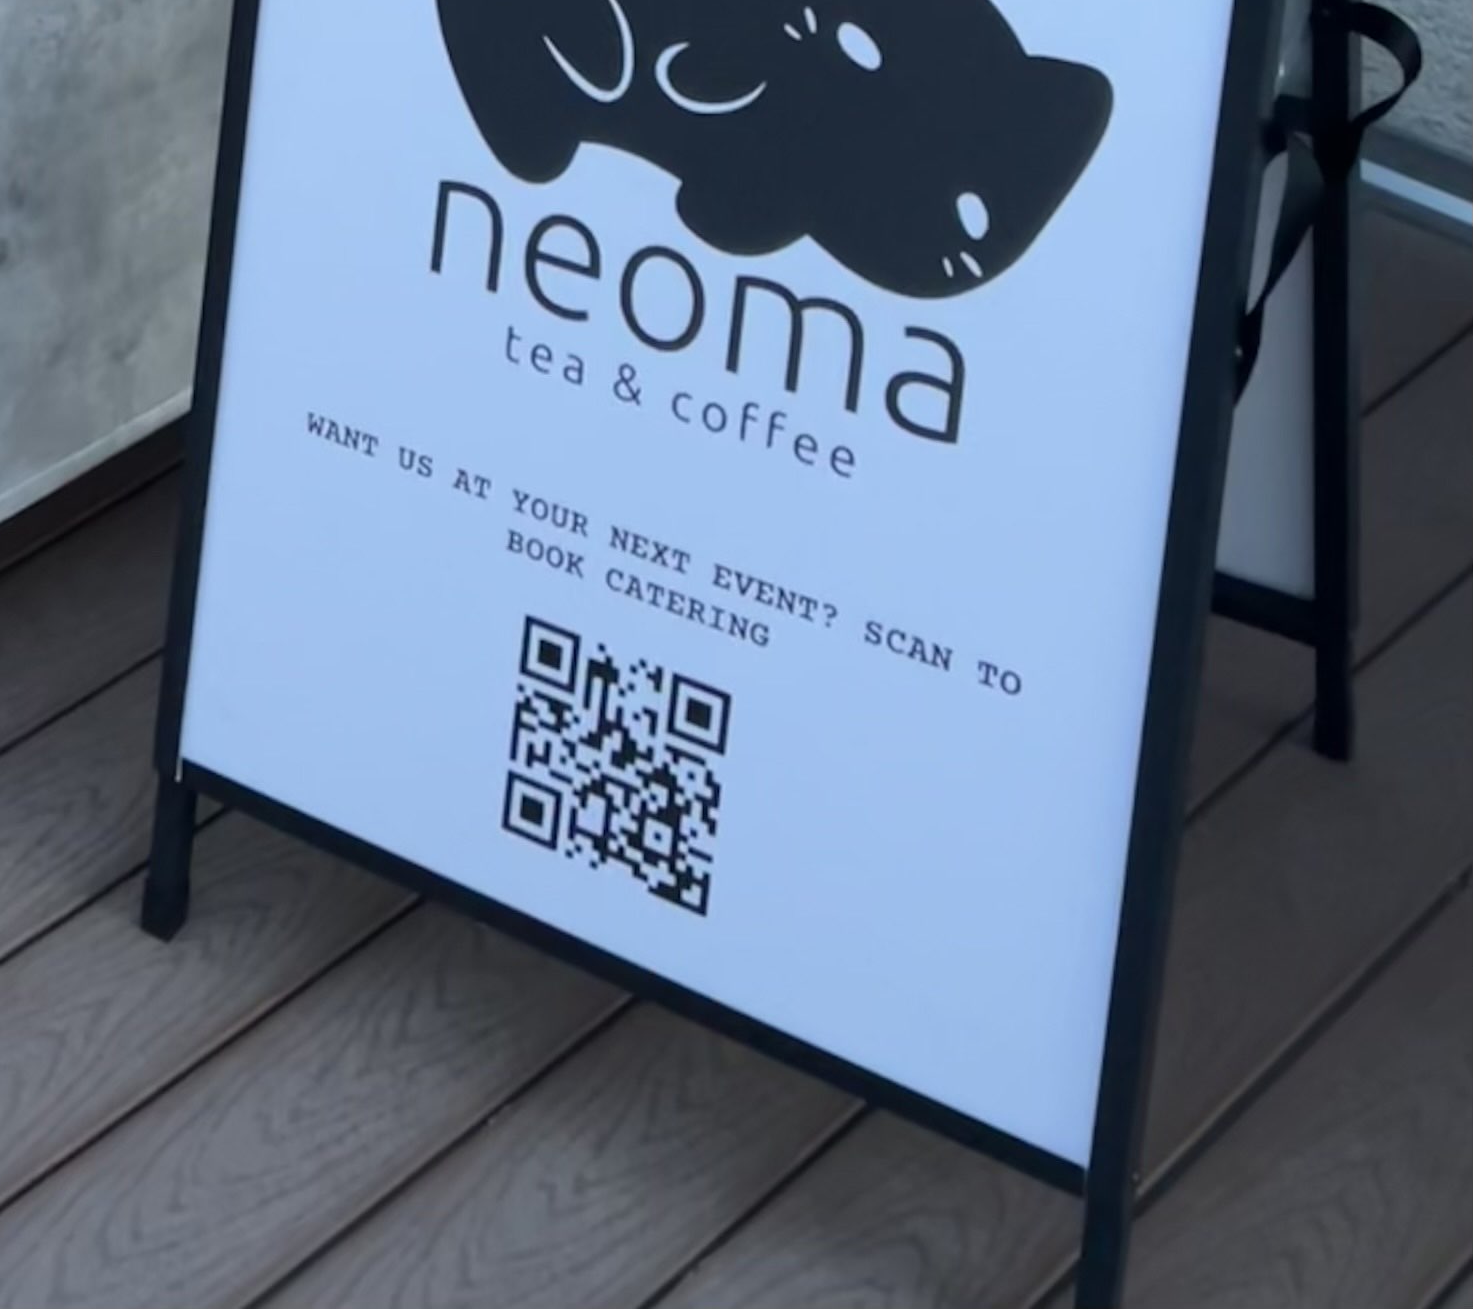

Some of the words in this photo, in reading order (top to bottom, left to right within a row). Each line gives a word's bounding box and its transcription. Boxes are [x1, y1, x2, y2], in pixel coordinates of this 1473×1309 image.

[429, 179, 966, 445] neoma
[505, 325, 585, 386] tea
[612, 362, 642, 406] &
[671, 392, 856, 479] coffee
[307, 411, 379, 457] WANT
[398, 446, 433, 478] US
[452, 468, 492, 500] AT
[512, 488, 588, 538] YOUR
[609, 525, 691, 575] NEXT
[712, 563, 839, 628] EVENT?
[864, 620, 953, 672] SCAN
[977, 660, 1022, 696] TO
[506, 528, 585, 579] BOOK
[605, 568, 770, 648] CATERING
